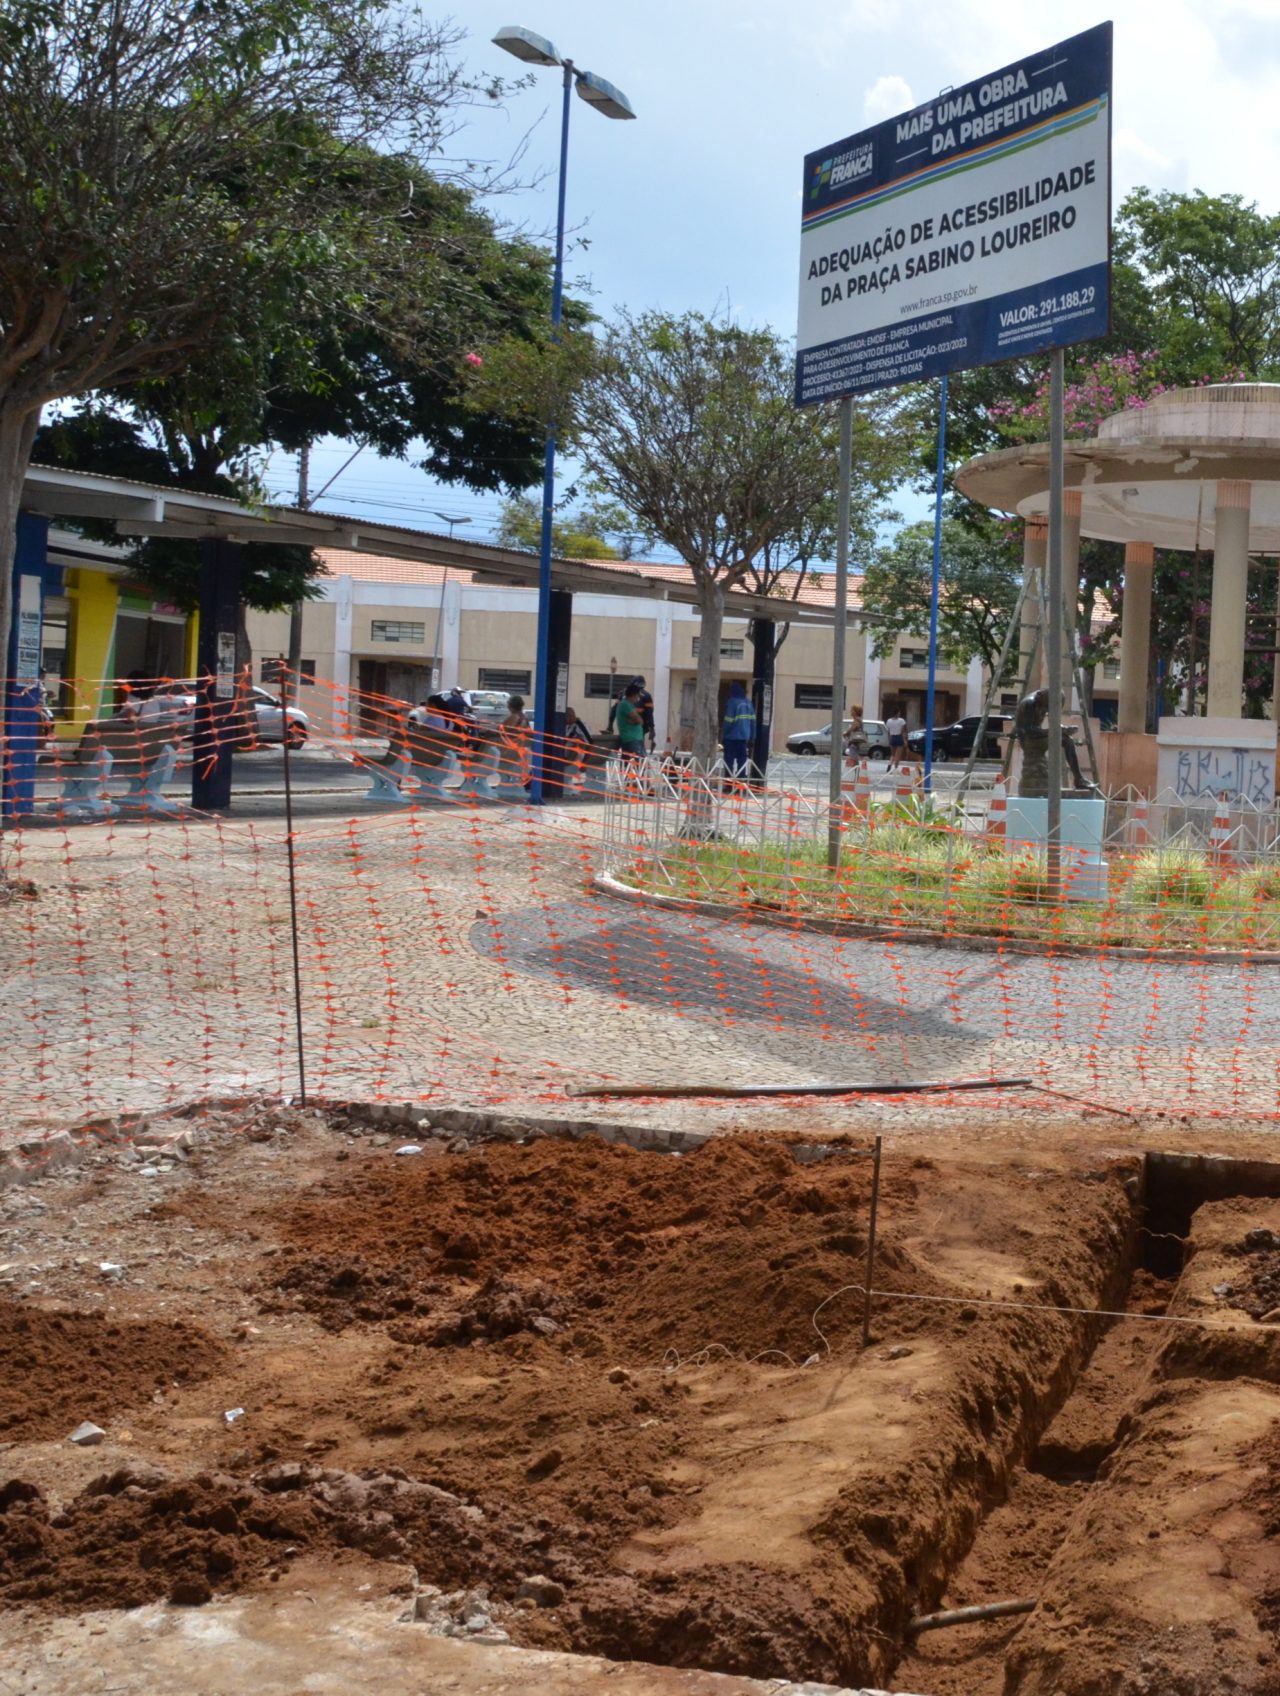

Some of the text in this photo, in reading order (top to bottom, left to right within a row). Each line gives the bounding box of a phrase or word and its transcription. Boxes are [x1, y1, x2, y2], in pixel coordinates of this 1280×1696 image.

[897, 69, 1029, 144] MAIS UMA OBRA
[932, 81, 1068, 155] DA PREFEITURA
[830, 152, 873, 185] FRANCA
[833, 142, 873, 167] PREFEITURA
[808, 160, 1096, 280] ADEQUAÇÃO DE ACESSIBILIDADE
[821, 205, 1077, 307] DA PRAÇA SABINO LOUREIRO
[900, 284, 979, 314] www.franca.sp.gov.br
[1000, 304, 1039, 328] VALOR:
[1040, 286, 1096, 317] 291.188,29
[804, 349, 829, 364] EMPRESA
[867, 332, 887, 346] EMDEF
[890, 324, 918, 340] EMPRESA
[919, 315, 954, 332] MUNICIPAL
[823, 348, 876, 370] DESENVOLVIMENTO
[876, 346, 884, 357] DE
[885, 339, 910, 354] FRANCA
[866, 355, 894, 371] DISPENSA
[895, 353, 903, 364] DE
[903, 345, 937, 361] LICITAÇÃO:
[938, 337, 968, 353] 023/2023
[802, 388, 816, 400] DATA
[816, 386, 824, 396] DE
[877, 368, 899, 381] PRAZO:
[908, 361, 923, 374] DIAS
